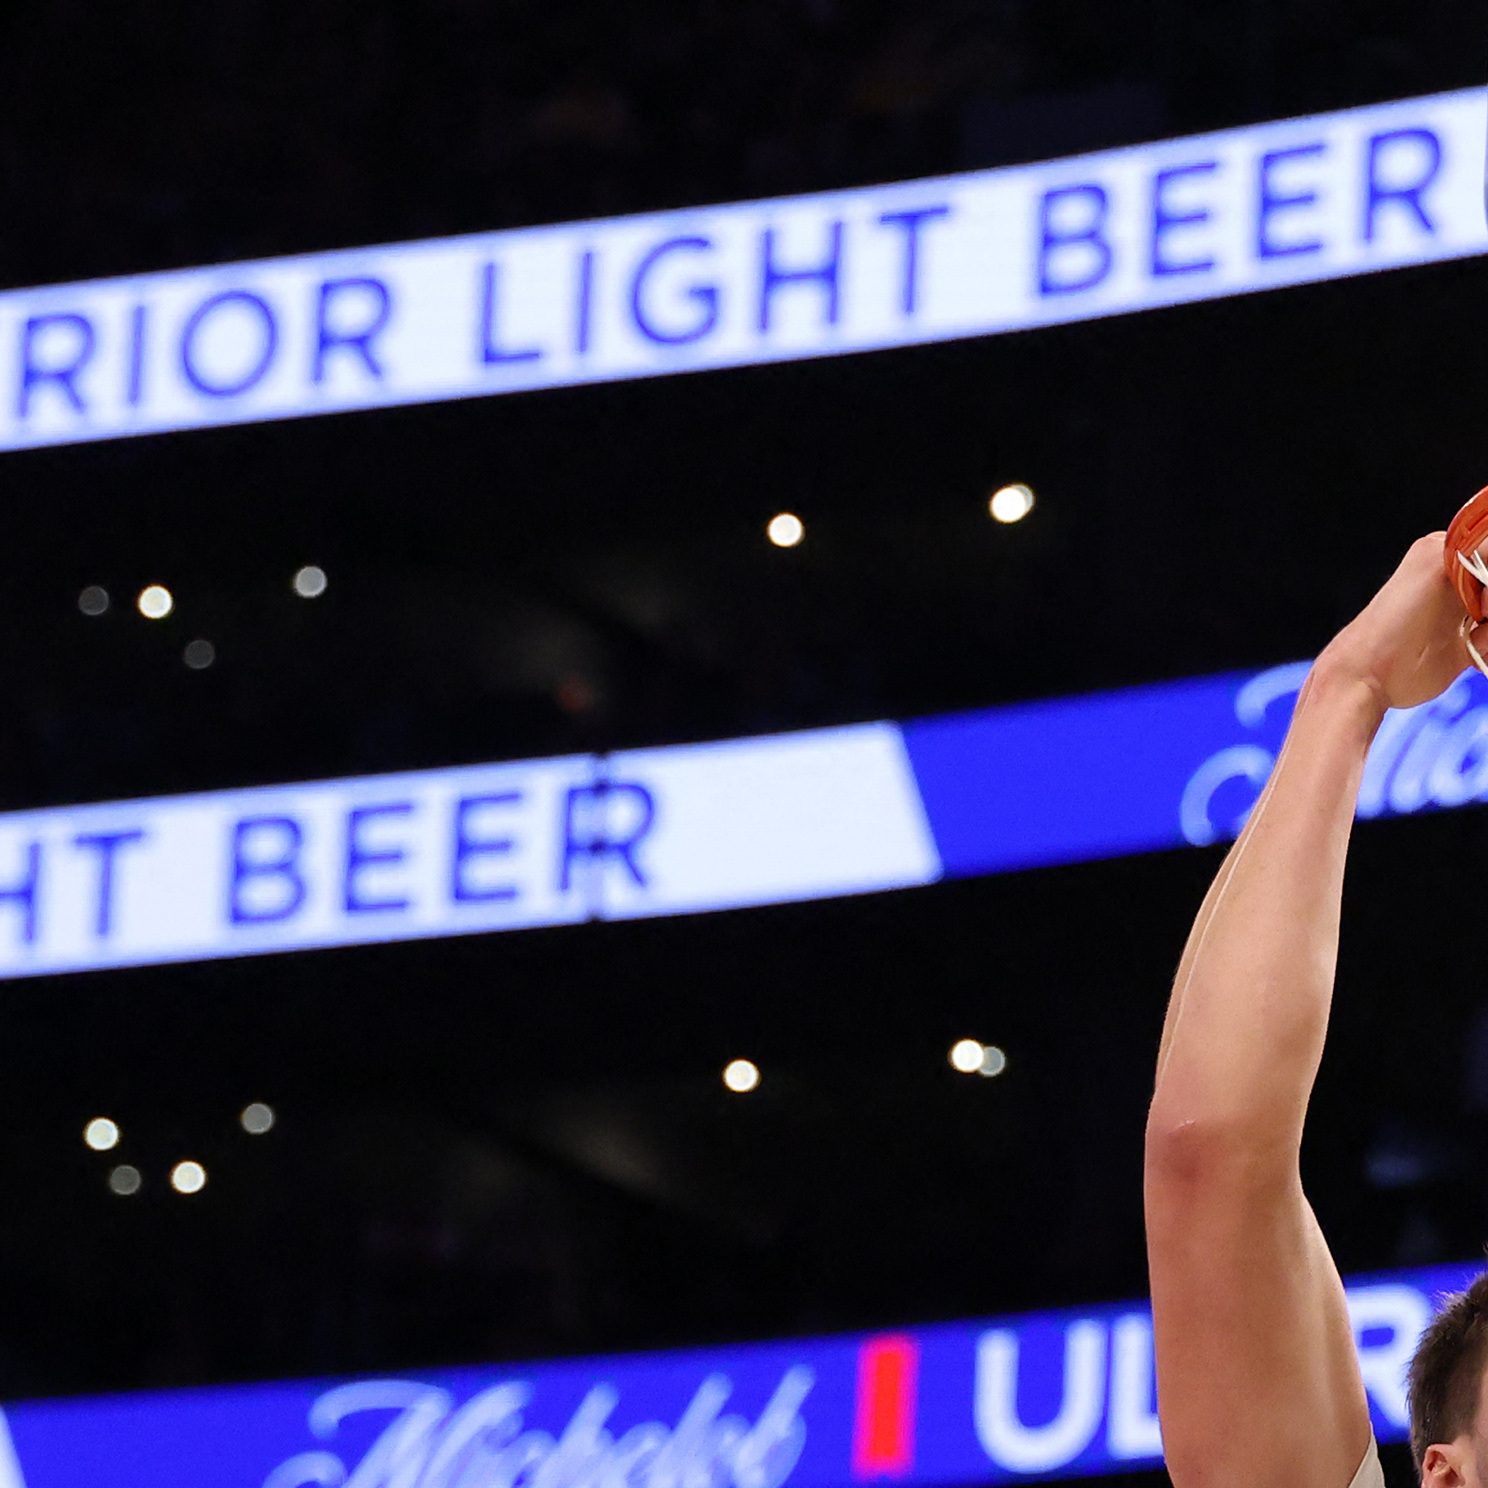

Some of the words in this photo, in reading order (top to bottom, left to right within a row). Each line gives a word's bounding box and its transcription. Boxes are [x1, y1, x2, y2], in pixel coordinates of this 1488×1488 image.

[19, 275, 393, 418] RIOR
[480, 204, 952, 367] LIGHT
[1036, 126, 1446, 298] BEER
[228, 779, 659, 925] BEER
